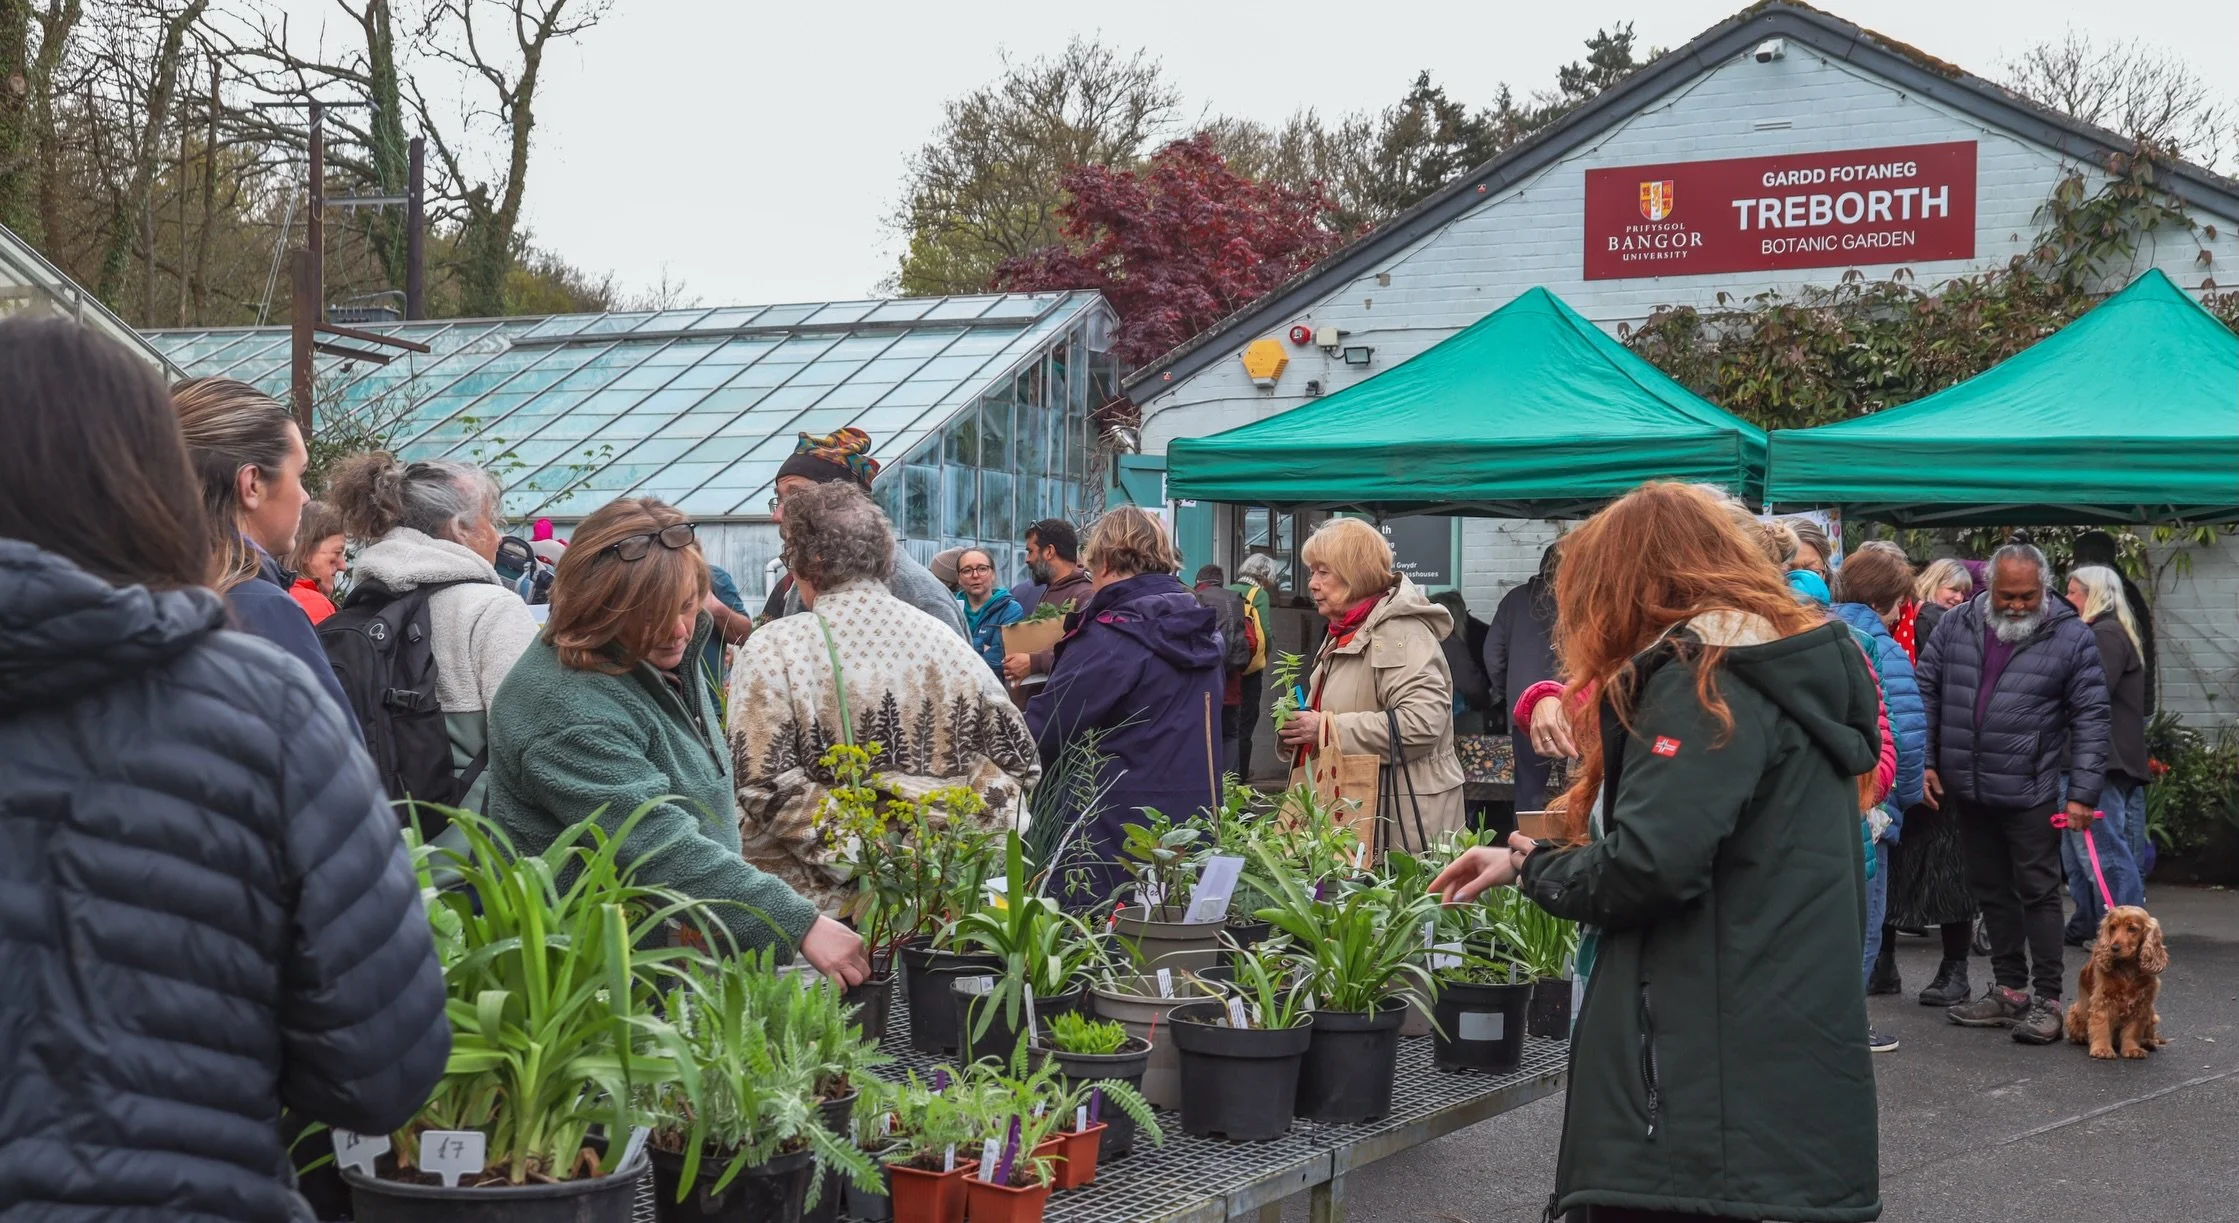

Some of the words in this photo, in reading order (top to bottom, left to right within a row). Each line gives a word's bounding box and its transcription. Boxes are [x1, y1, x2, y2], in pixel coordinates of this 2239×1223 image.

[1762, 168, 1826, 188] GARDD
[1830, 161, 1918, 183] FOTANEG
[1731, 184, 1949, 231] TREBORTH
[1625, 222, 1686, 233] PRIFYSGOL
[1607, 231, 1703, 251] BANGOR
[1761, 235, 1838, 255] BOTANIC
[1841, 229, 1916, 250] GARDEN
[1622, 250, 1688, 261] UNIVERSITY
[1396, 561, 1417, 570] Gwydr
